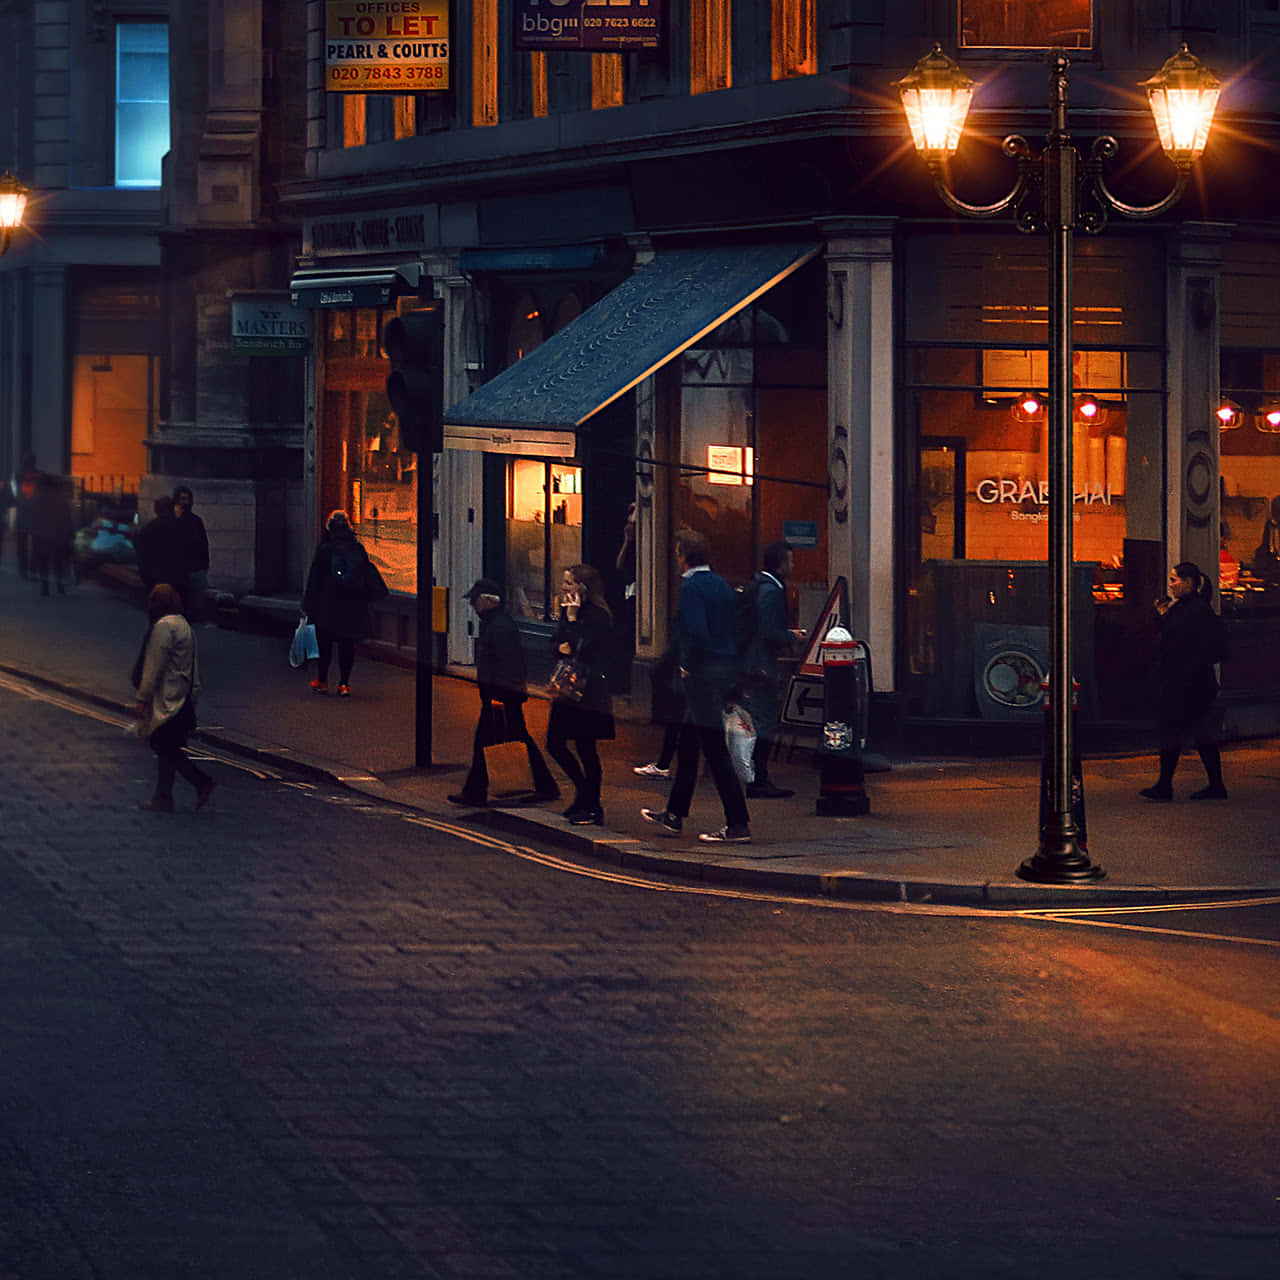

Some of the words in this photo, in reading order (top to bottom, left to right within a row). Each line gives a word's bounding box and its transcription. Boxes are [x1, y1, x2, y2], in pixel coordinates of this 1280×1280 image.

[356, 2, 420, 13] OFFICES
[338, 17, 375, 35] TO
[387, 16, 439, 35] LET
[328, 44, 373, 59] PEARL
[378, 44, 388, 58] &
[393, 43, 448, 58] COUTTS
[332, 68, 359, 80] 020
[364, 67, 401, 80] 7843
[406, 66, 444, 79] 3788
[237, 320, 306, 336] MASTERS
